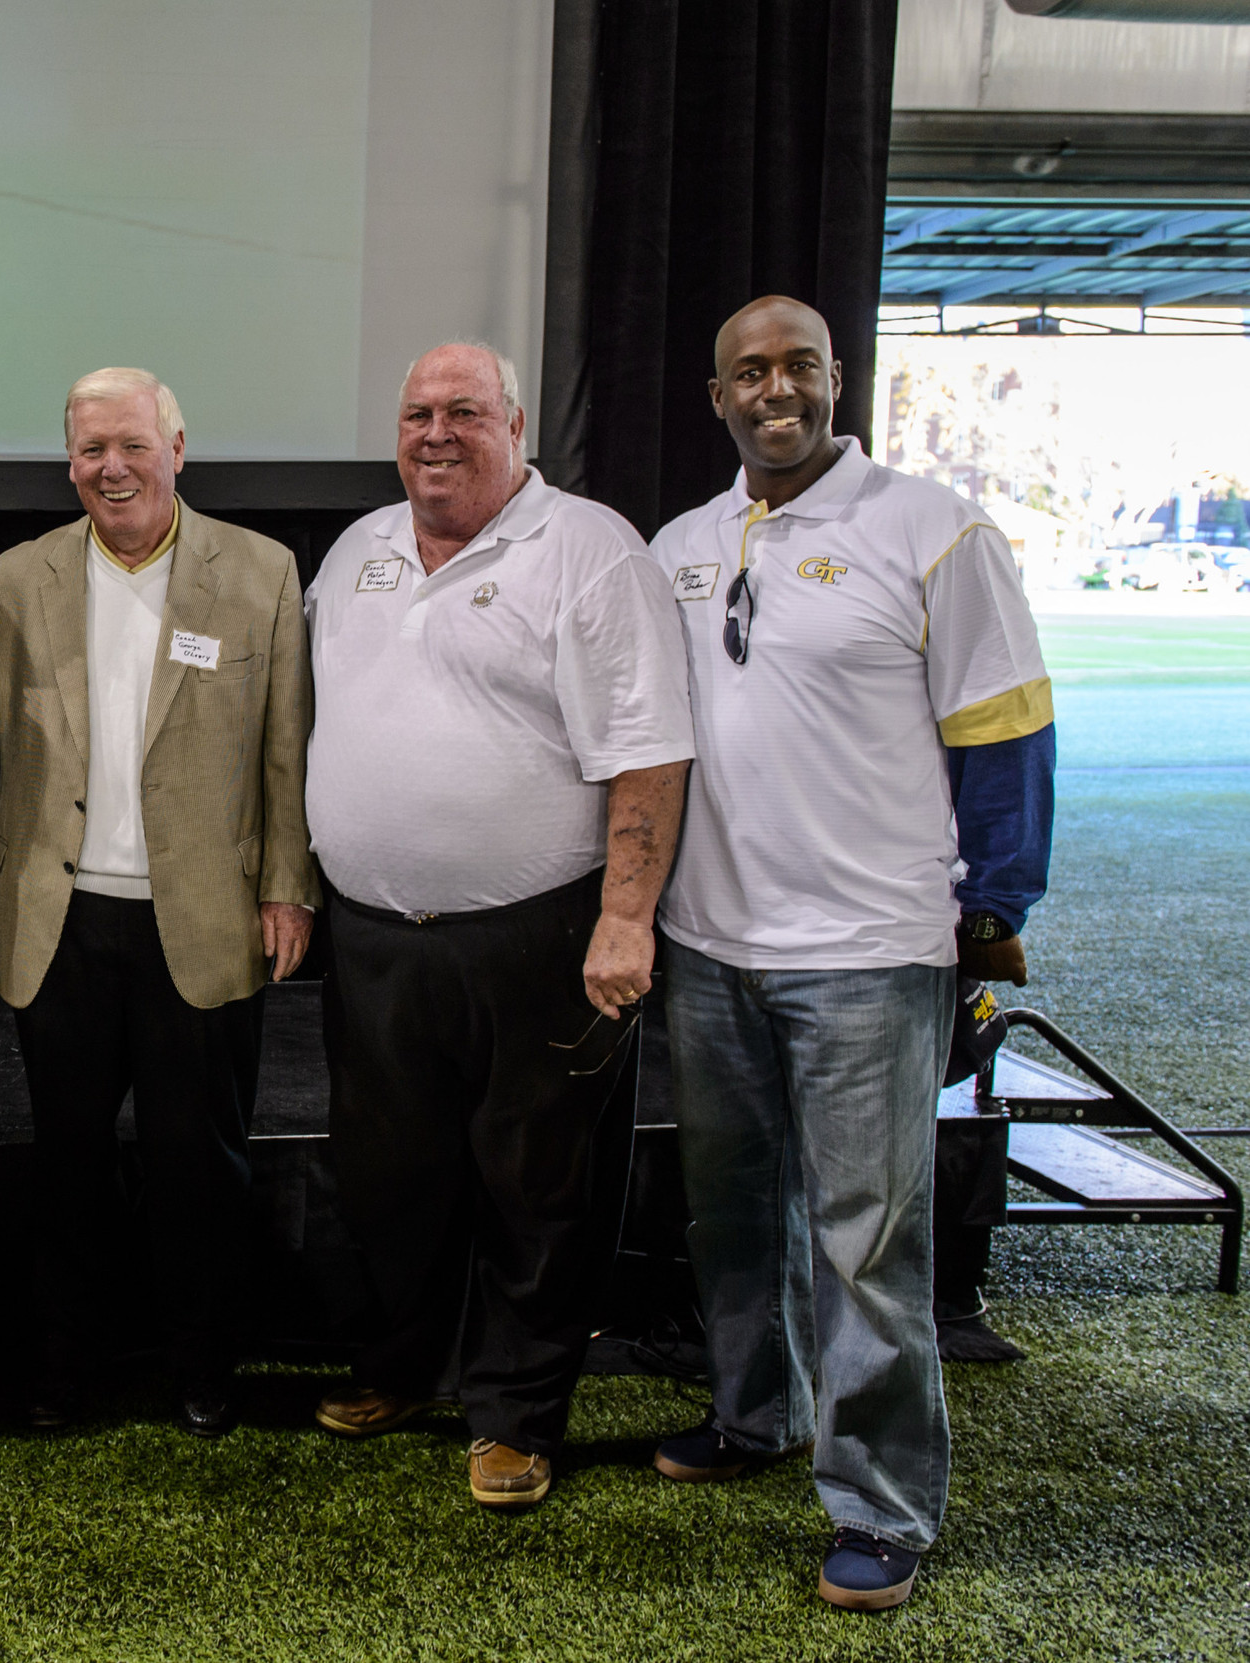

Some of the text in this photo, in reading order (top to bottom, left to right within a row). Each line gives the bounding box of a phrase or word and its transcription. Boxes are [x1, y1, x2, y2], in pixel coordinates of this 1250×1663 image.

[366, 563, 386, 571] Coach
[797, 557, 848, 584] GT
[175, 633, 197, 642] Coach
